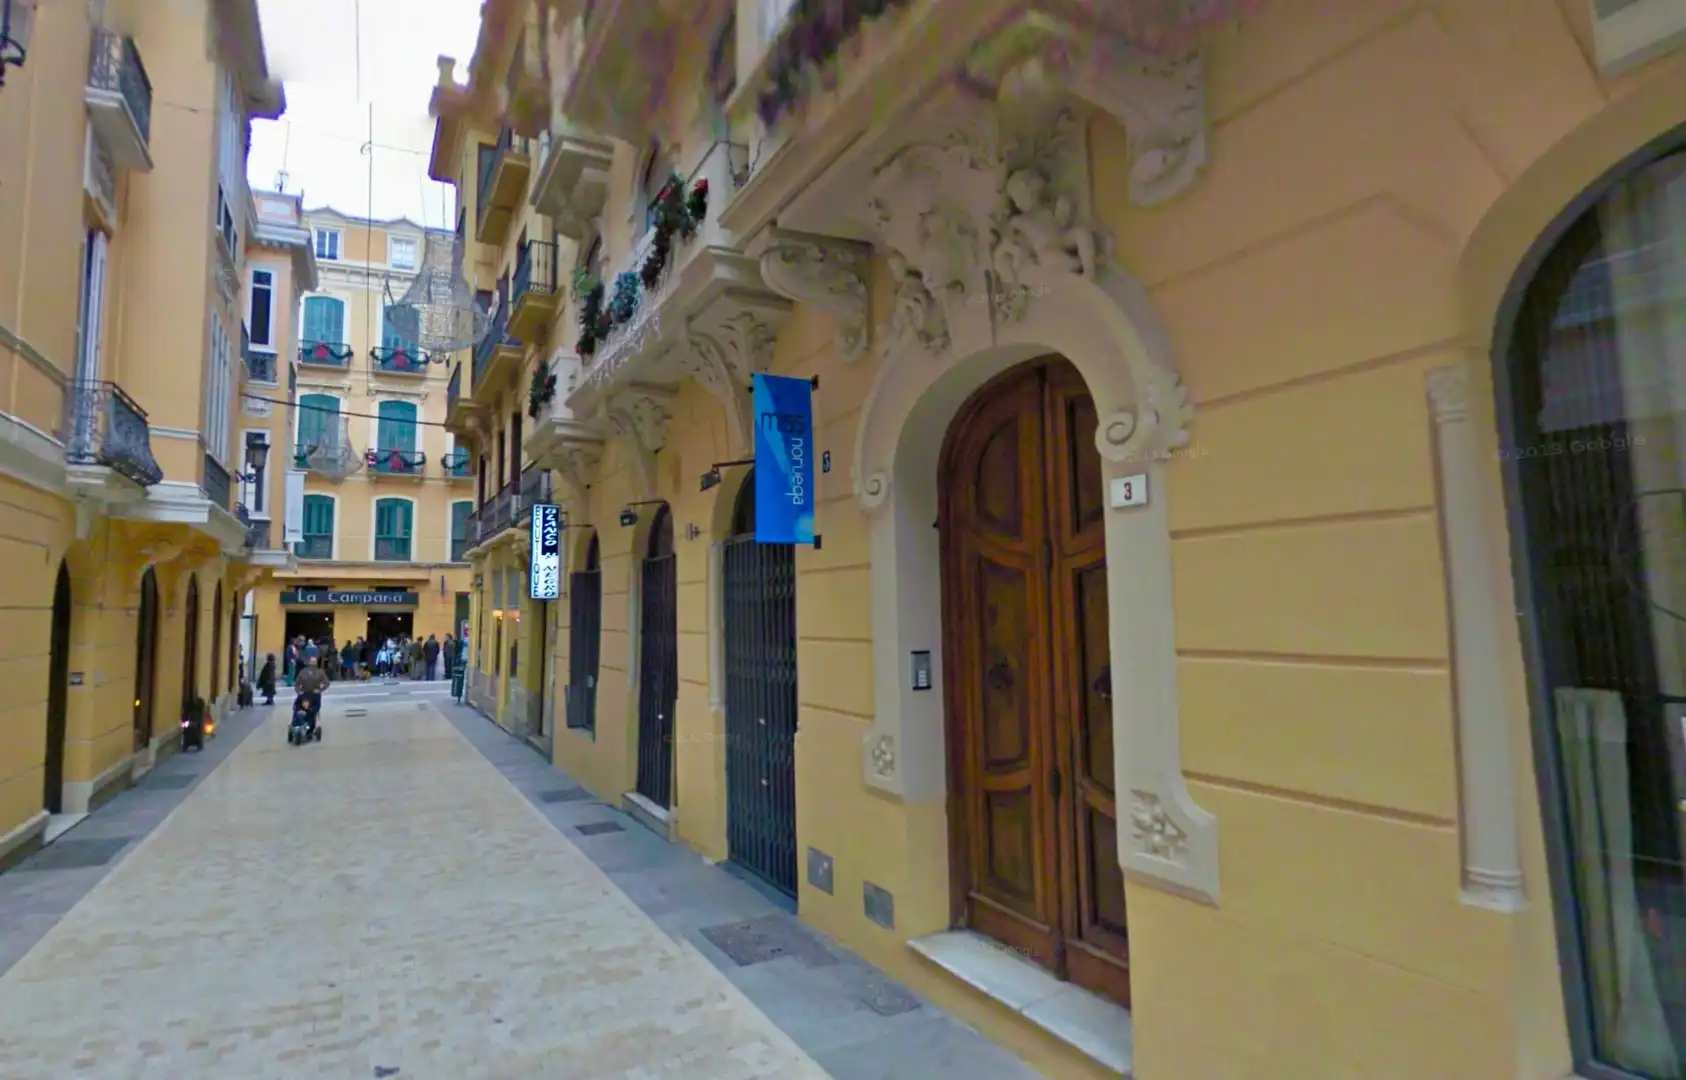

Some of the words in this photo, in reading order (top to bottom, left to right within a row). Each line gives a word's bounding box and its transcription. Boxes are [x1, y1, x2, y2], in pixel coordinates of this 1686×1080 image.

[1123, 481, 1133, 502] 3
[297, 587, 317, 603] La
[328, 591, 403, 604] Campana
